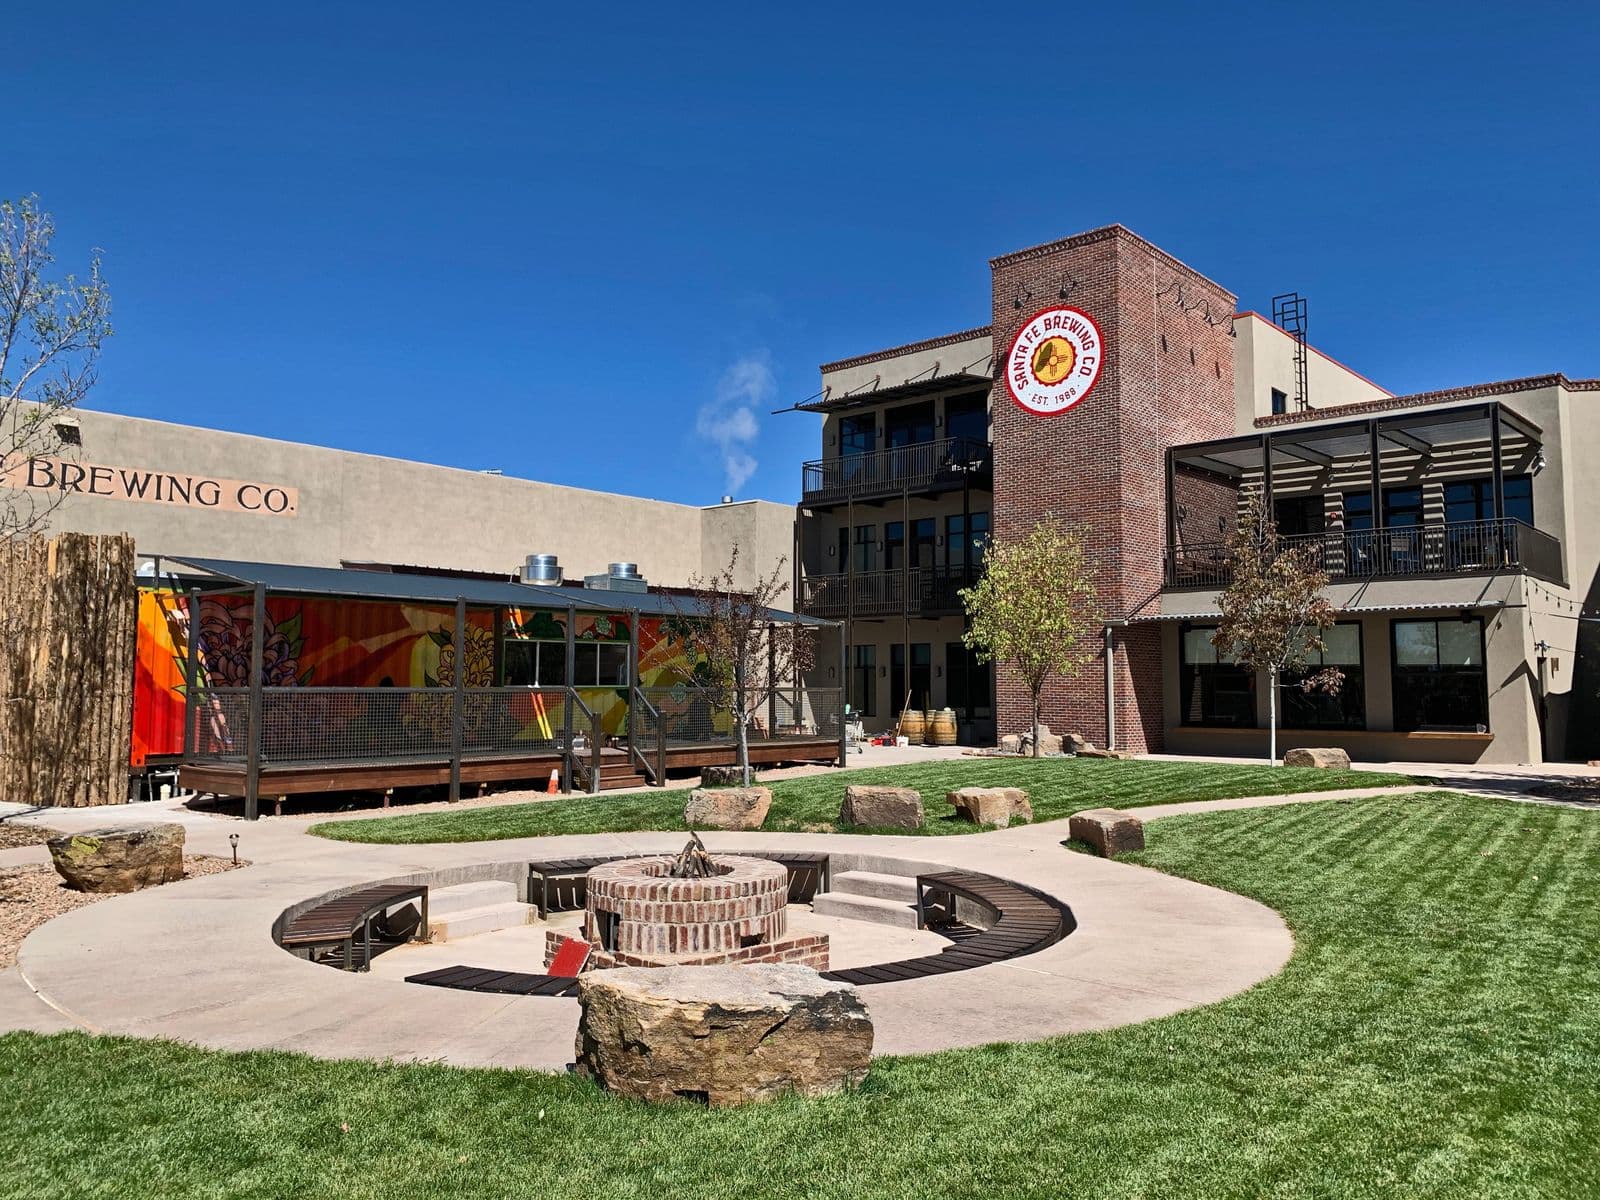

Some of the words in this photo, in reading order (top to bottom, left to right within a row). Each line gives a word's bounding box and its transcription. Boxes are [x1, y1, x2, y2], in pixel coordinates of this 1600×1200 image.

[1014, 345, 1029, 390] SANTA
[1024, 325, 1041, 344] FE
[1044, 315, 1095, 351] BREWING
[1032, 393, 1049, 406] EST.
[26, 458, 221, 506] BREWING
[237, 485, 295, 513] CO.
